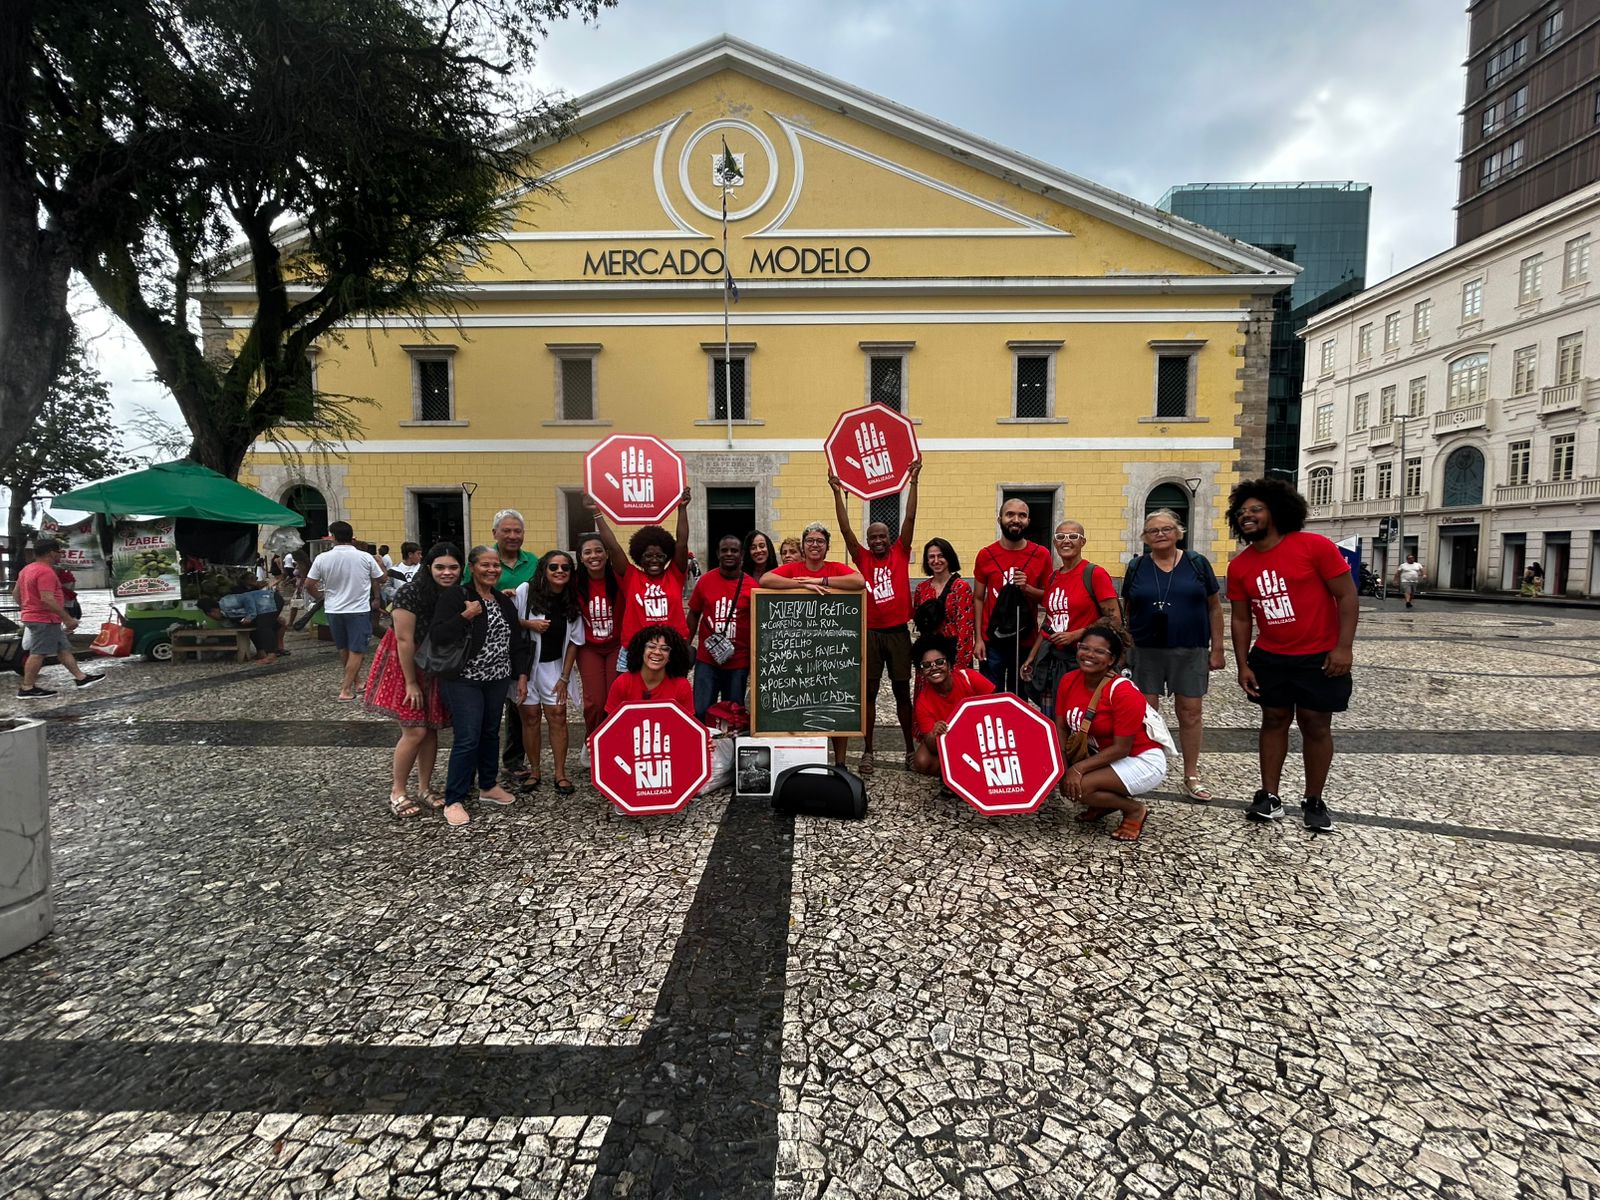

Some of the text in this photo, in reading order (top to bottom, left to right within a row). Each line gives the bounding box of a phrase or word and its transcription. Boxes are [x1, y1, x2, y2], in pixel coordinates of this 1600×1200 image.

[583, 246, 871, 276] MERCADO MODELO
[861, 451, 893, 479] RUA
[867, 474, 895, 485] SINALIZADA
[622, 478, 654, 502] RUA
[125, 536, 165, 546] IZABEL
[871, 580, 895, 600] RUA
[644, 598, 668, 617] RUA
[769, 600, 858, 620] MENU POÉTICO
[1261, 596, 1295, 620] RUA
[806, 620, 818, 628] NA
[820, 619, 839, 628] RUA
[769, 643, 849, 663] SAMBA DE FAVELA
[772, 639, 812, 650] ESPELHO
[768, 660, 788, 676] AXÉ
[768, 672, 838, 691] POESIA ABERTA
[635, 759, 672, 789] RUA
[982, 755, 1024, 787] RUA
[988, 786, 1025, 795] SINALIZADA
